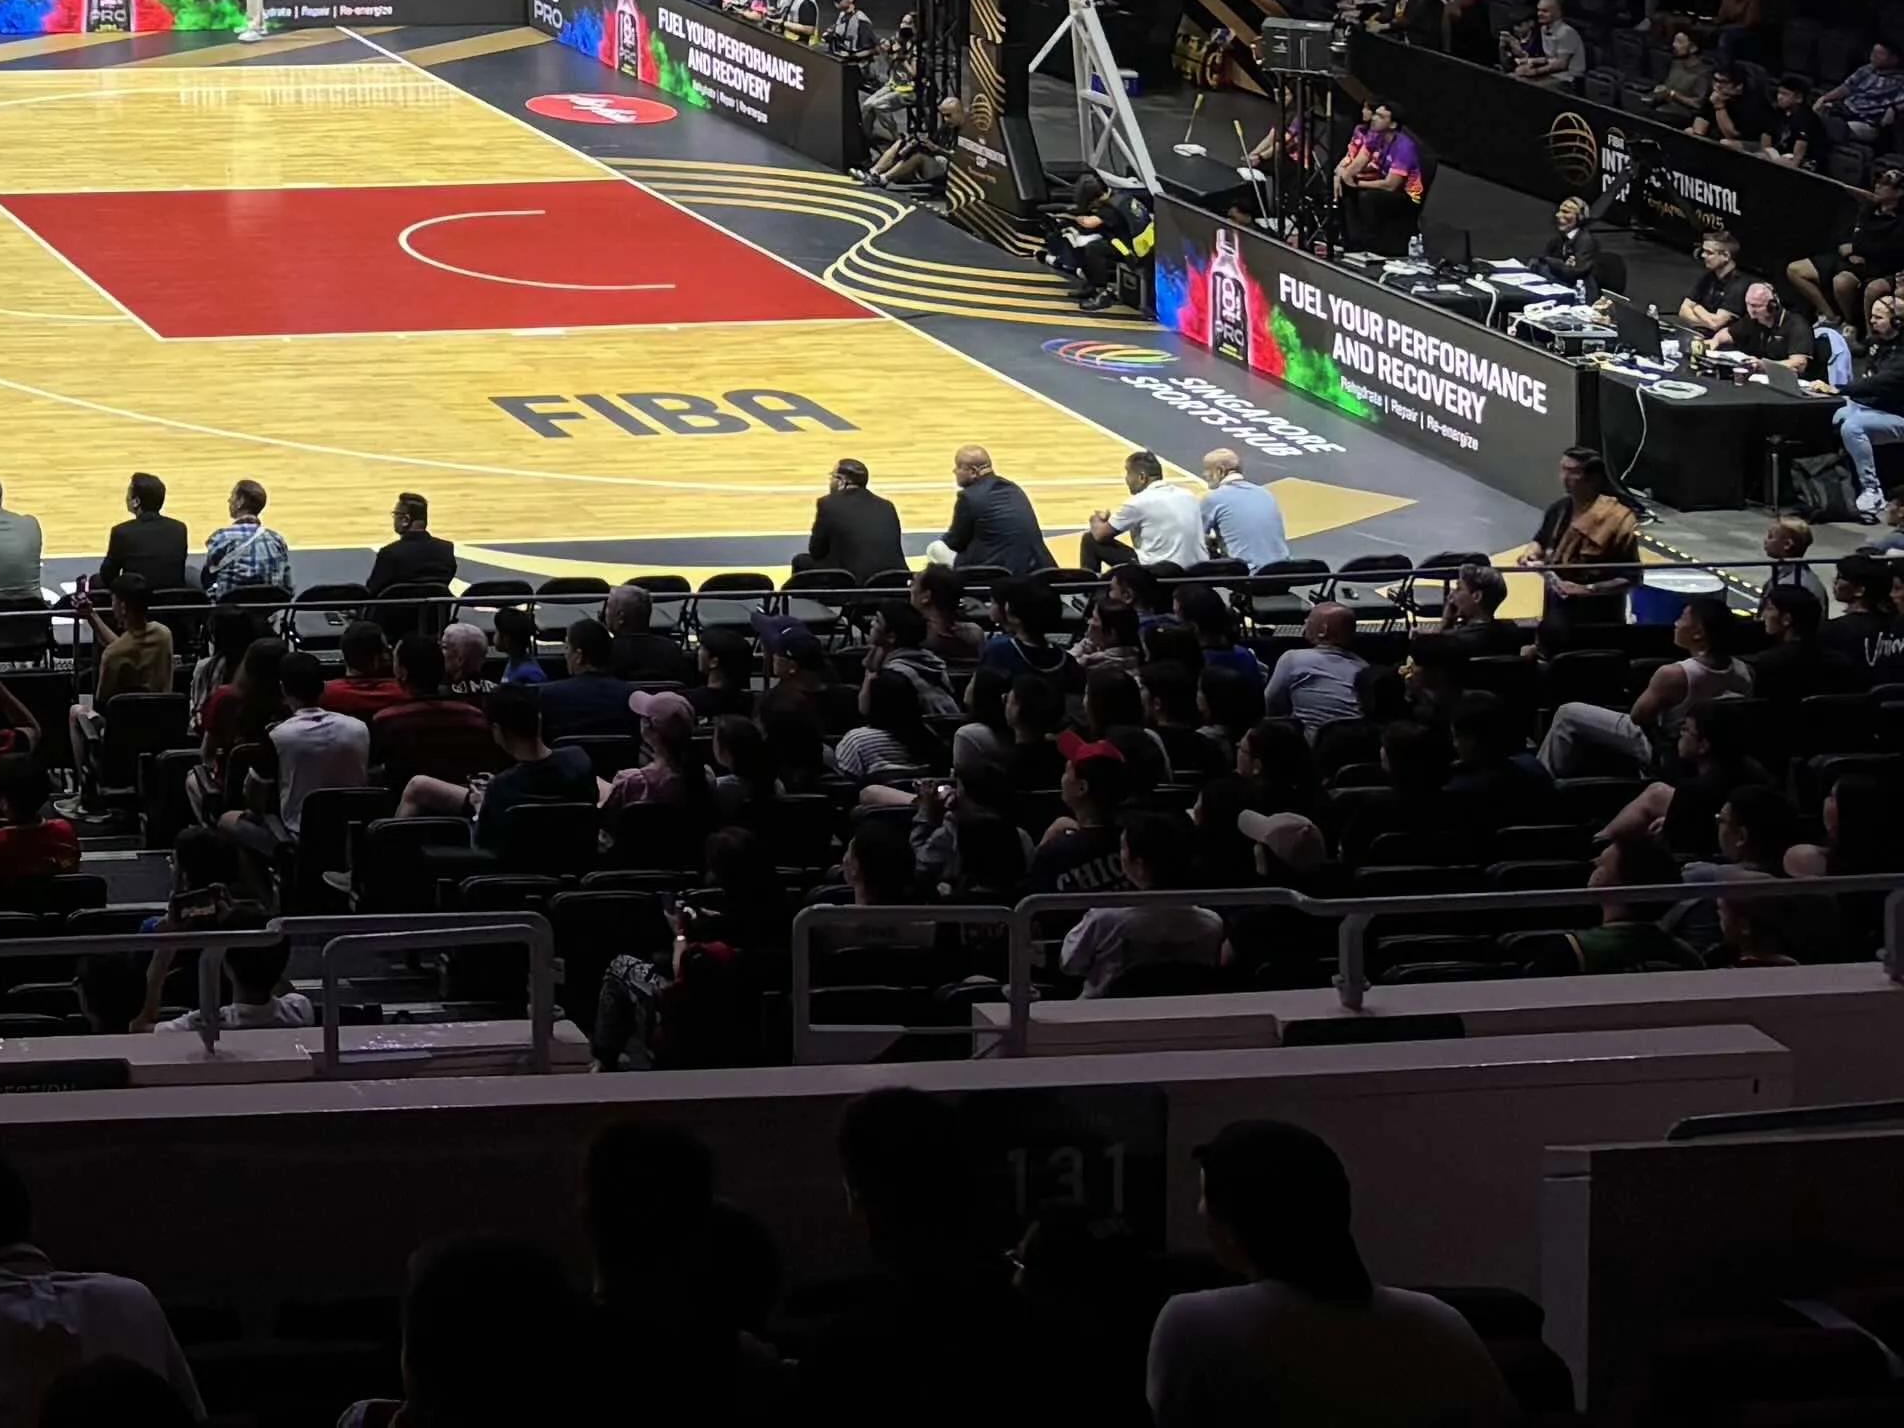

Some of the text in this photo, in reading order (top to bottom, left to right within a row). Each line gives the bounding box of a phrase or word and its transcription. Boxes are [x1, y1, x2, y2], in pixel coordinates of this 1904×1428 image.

[534, 0, 564, 30] PRO
[658, 7, 805, 91] FUEL YOUR PERFORMANCE
[688, 46, 771, 104] AND RECOVERY
[1215, 321, 1245, 348] PRO
[1279, 272, 1547, 415] FUEL YOUR PERFORMANCE
[488, 388, 862, 439] FIBA
[1119, 374, 1303, 458] SPORTS HUB
[1168, 374, 1346, 455] SINGAPORE
[1332, 332, 1488, 425] AND RECOVERY
